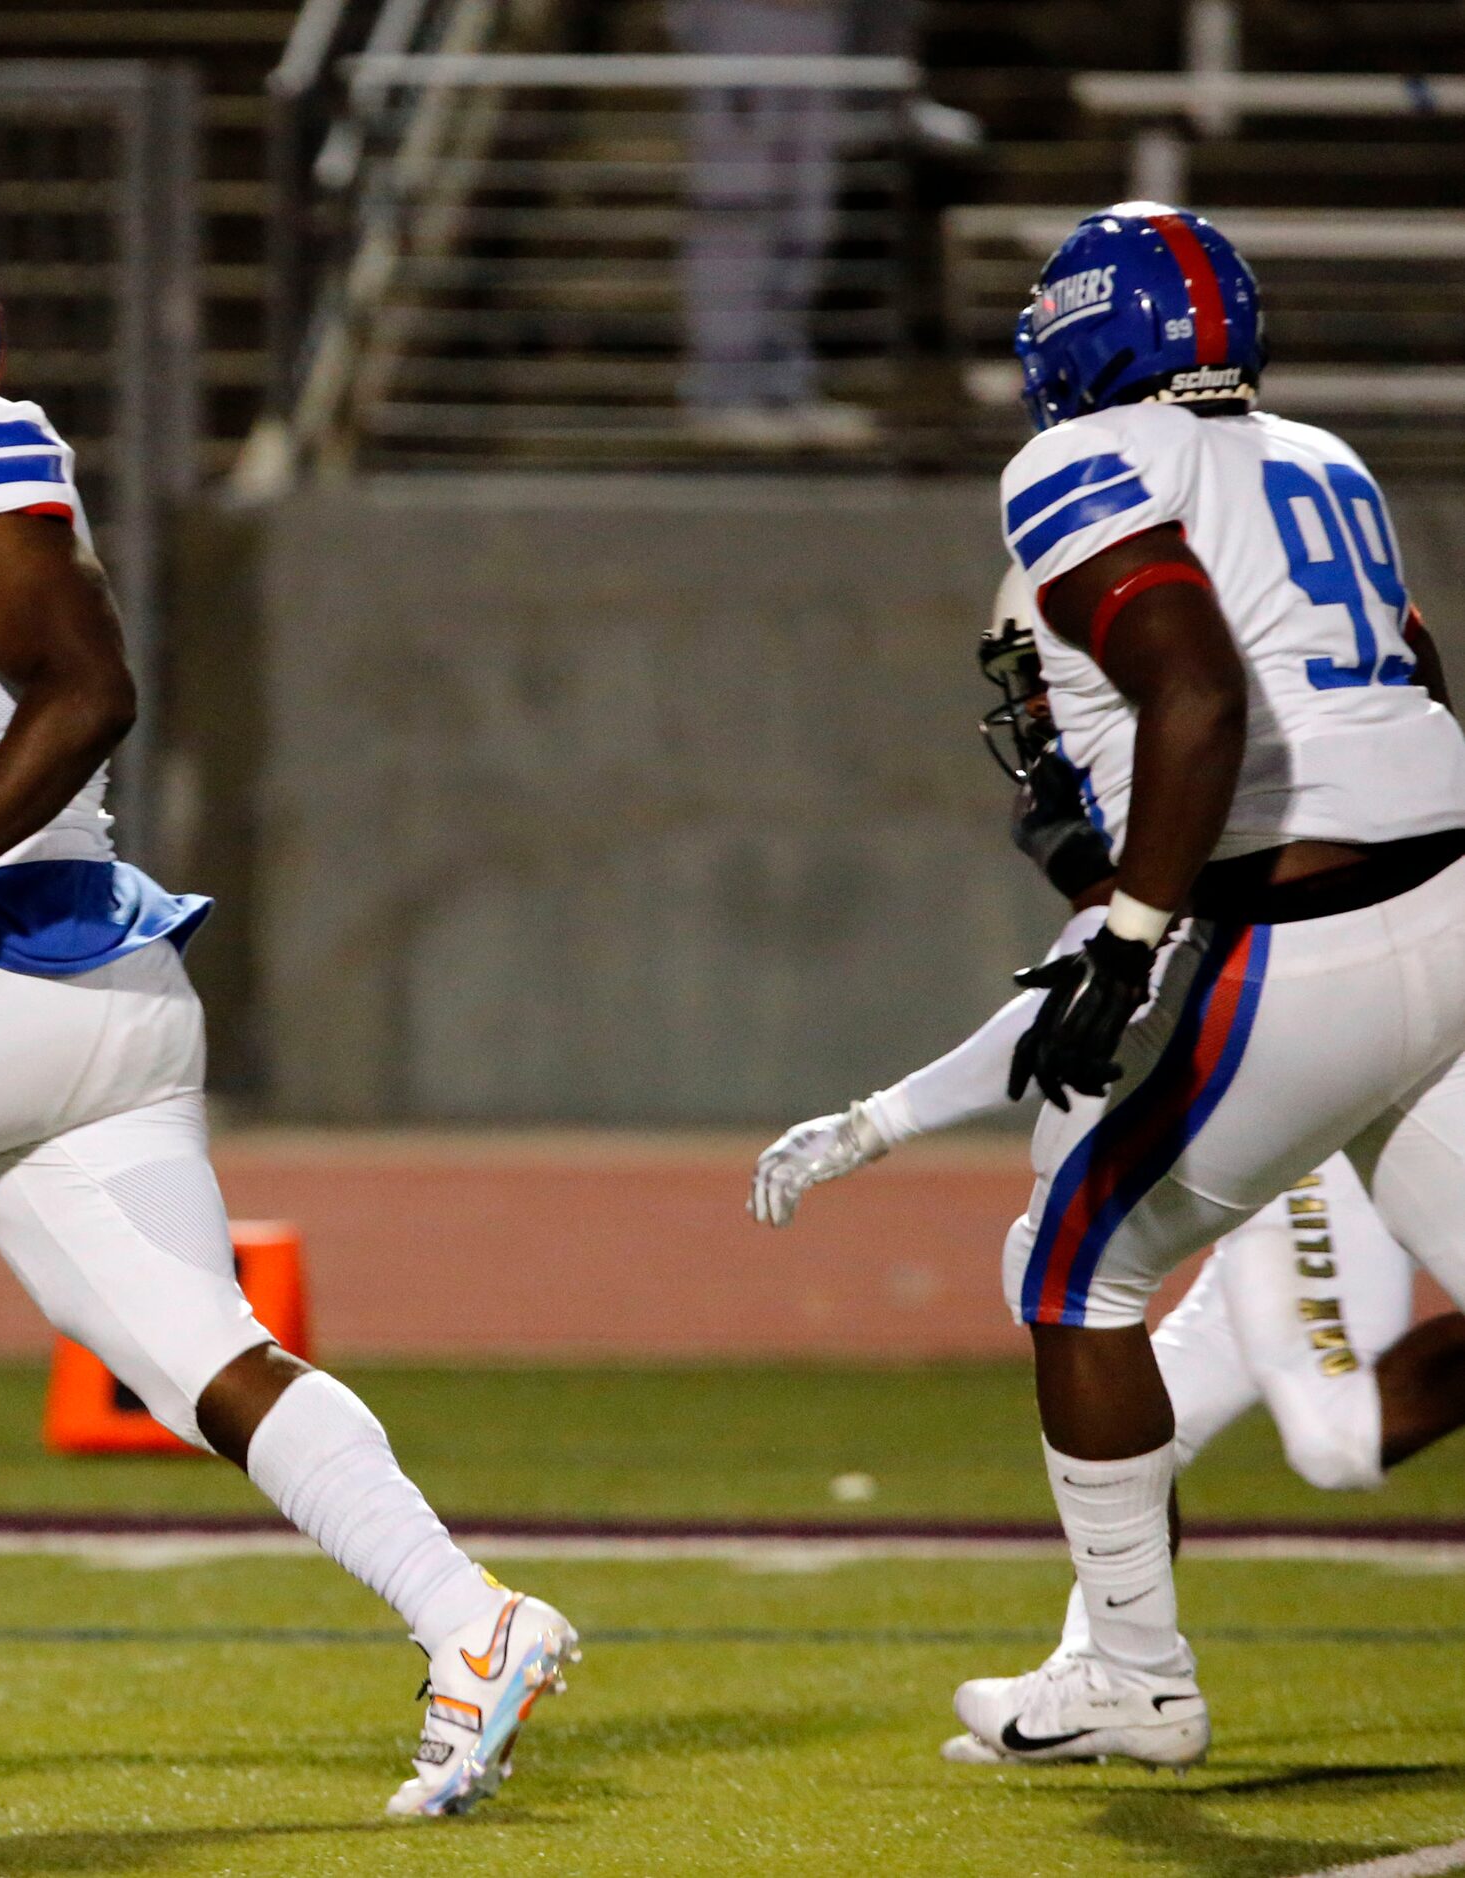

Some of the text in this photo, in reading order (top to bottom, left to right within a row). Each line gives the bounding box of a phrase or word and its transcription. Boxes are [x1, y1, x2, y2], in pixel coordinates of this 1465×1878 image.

[1032, 264, 1117, 334] NTHERS
[1164, 318, 1194, 341] 99
[1169, 364, 1242, 391] schutt
[1261, 460, 1417, 691] 99
